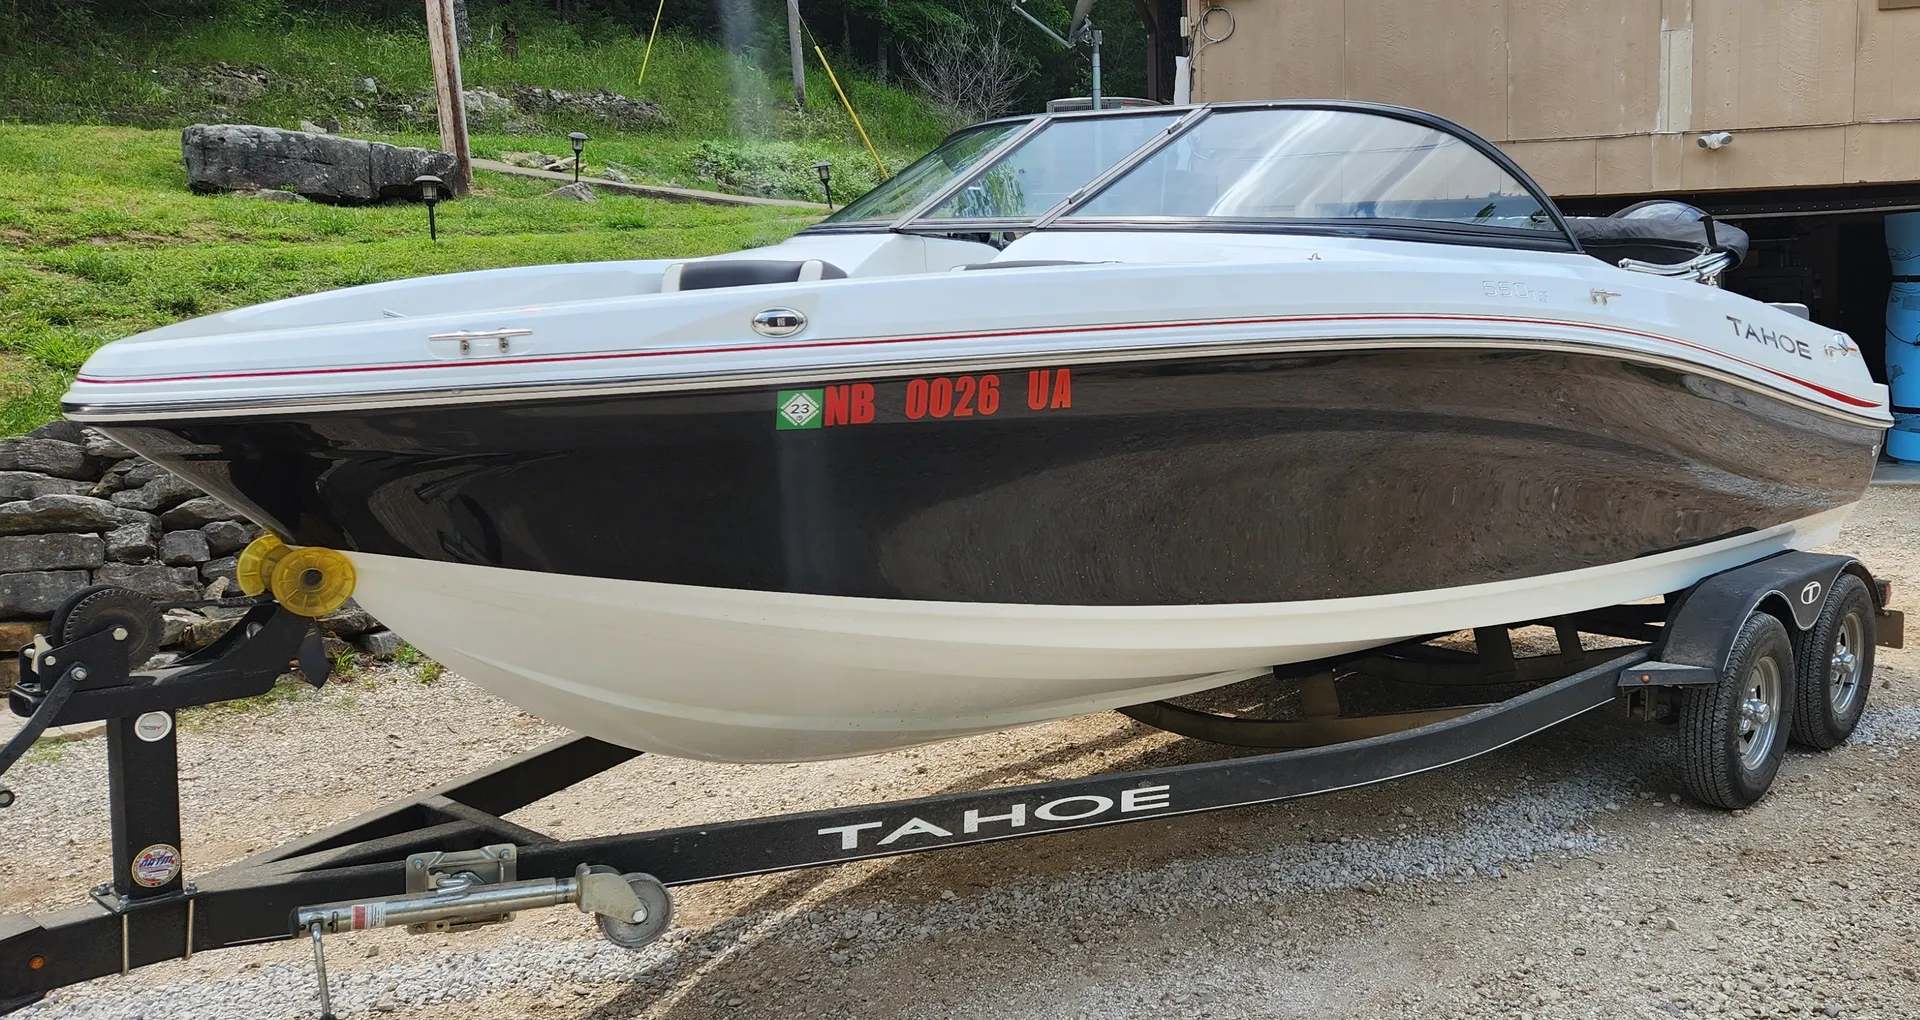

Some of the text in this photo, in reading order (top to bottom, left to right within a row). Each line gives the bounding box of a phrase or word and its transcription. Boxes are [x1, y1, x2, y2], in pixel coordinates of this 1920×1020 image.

[1726, 315, 1813, 360] TAHOE
[790, 403, 810, 414] 23
[824, 383, 875, 426] NB
[905, 374, 1000, 420] 0026
[1027, 368, 1072, 411] UA
[817, 784, 1170, 850] TAHOE
